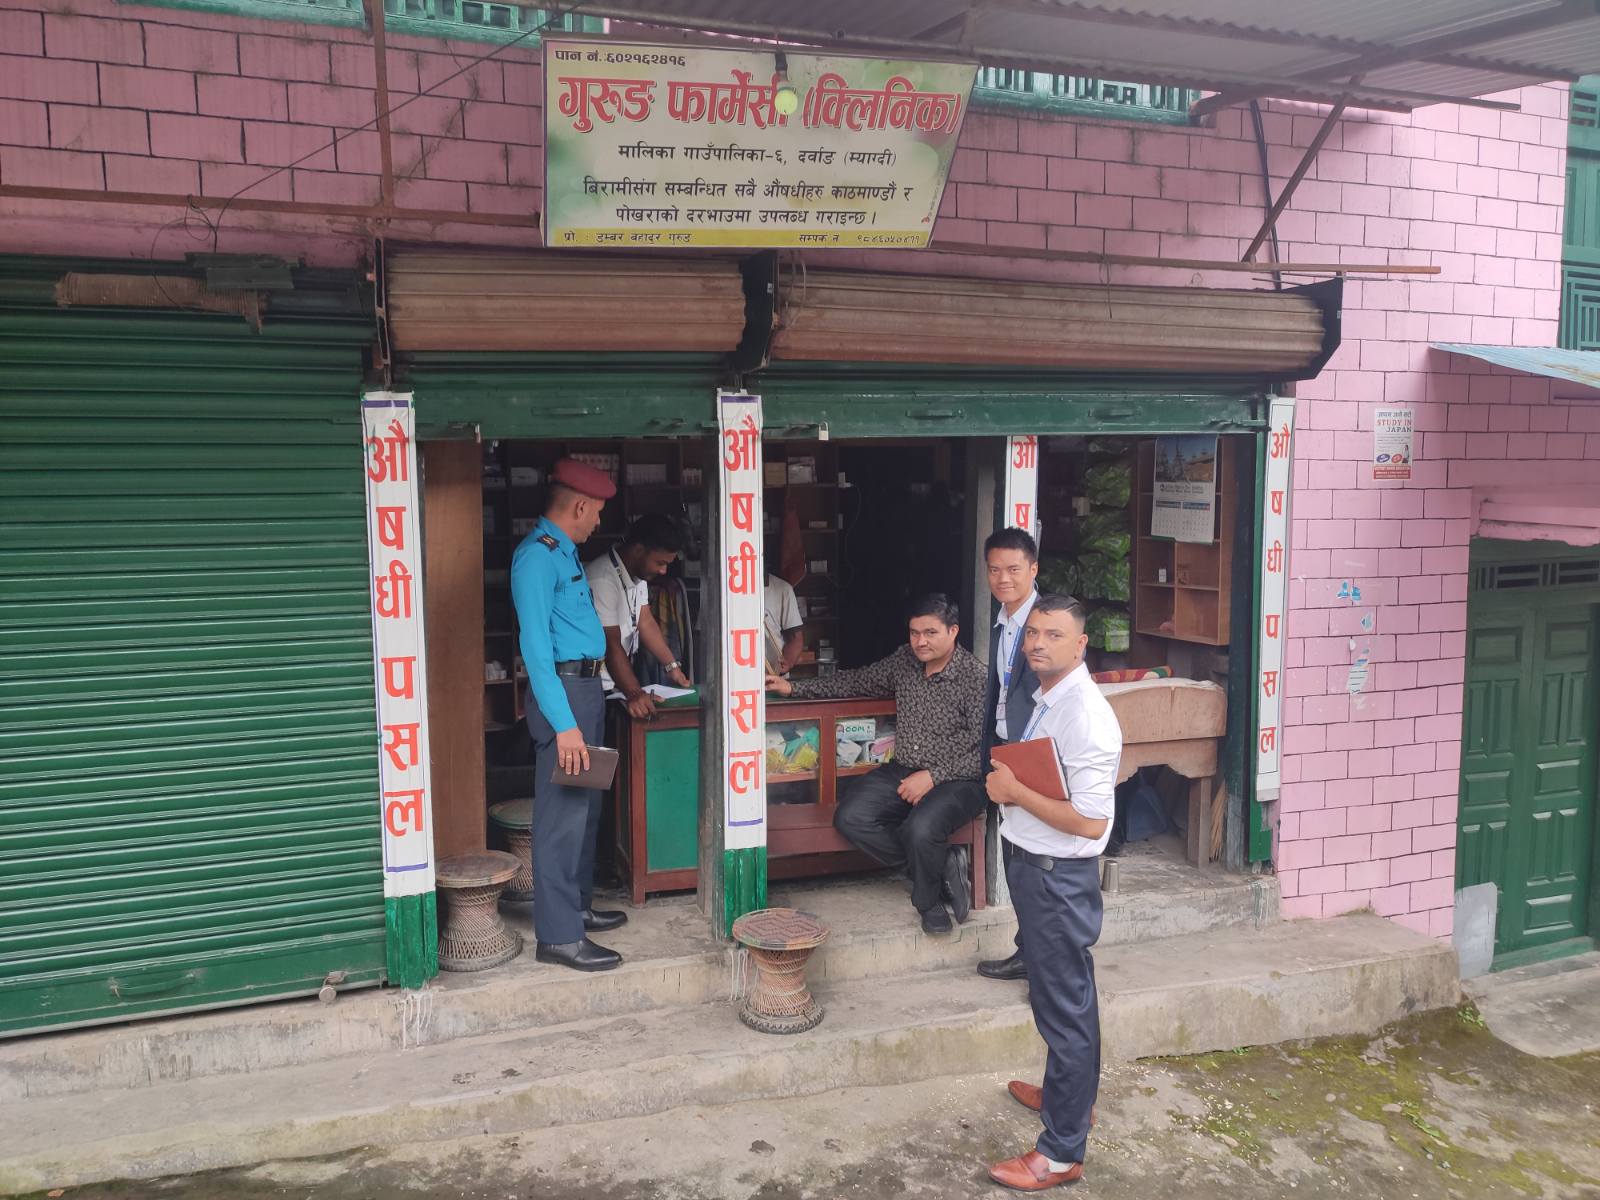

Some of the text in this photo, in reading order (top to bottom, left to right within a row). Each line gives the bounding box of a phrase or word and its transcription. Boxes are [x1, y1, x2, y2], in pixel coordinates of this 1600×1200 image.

[802, 72, 962, 134] (क्लिनिक)
[618, 141, 676, 160] मालिका
[583, 175, 657, 197] बिरामीसंग
[665, 177, 728, 197] सम्बन्धित
[734, 178, 757, 197] सबै
[903, 187, 914, 201] र
[616, 204, 680, 223] पोखराको
[686, 209, 752, 223] दरभाउमा
[758, 209, 810, 224] उपलब्ध
[816, 210, 867, 226] गराइन्छ
[1377, 418, 1412, 427] STUDY IN
[1011, 435, 1038, 530] औष
